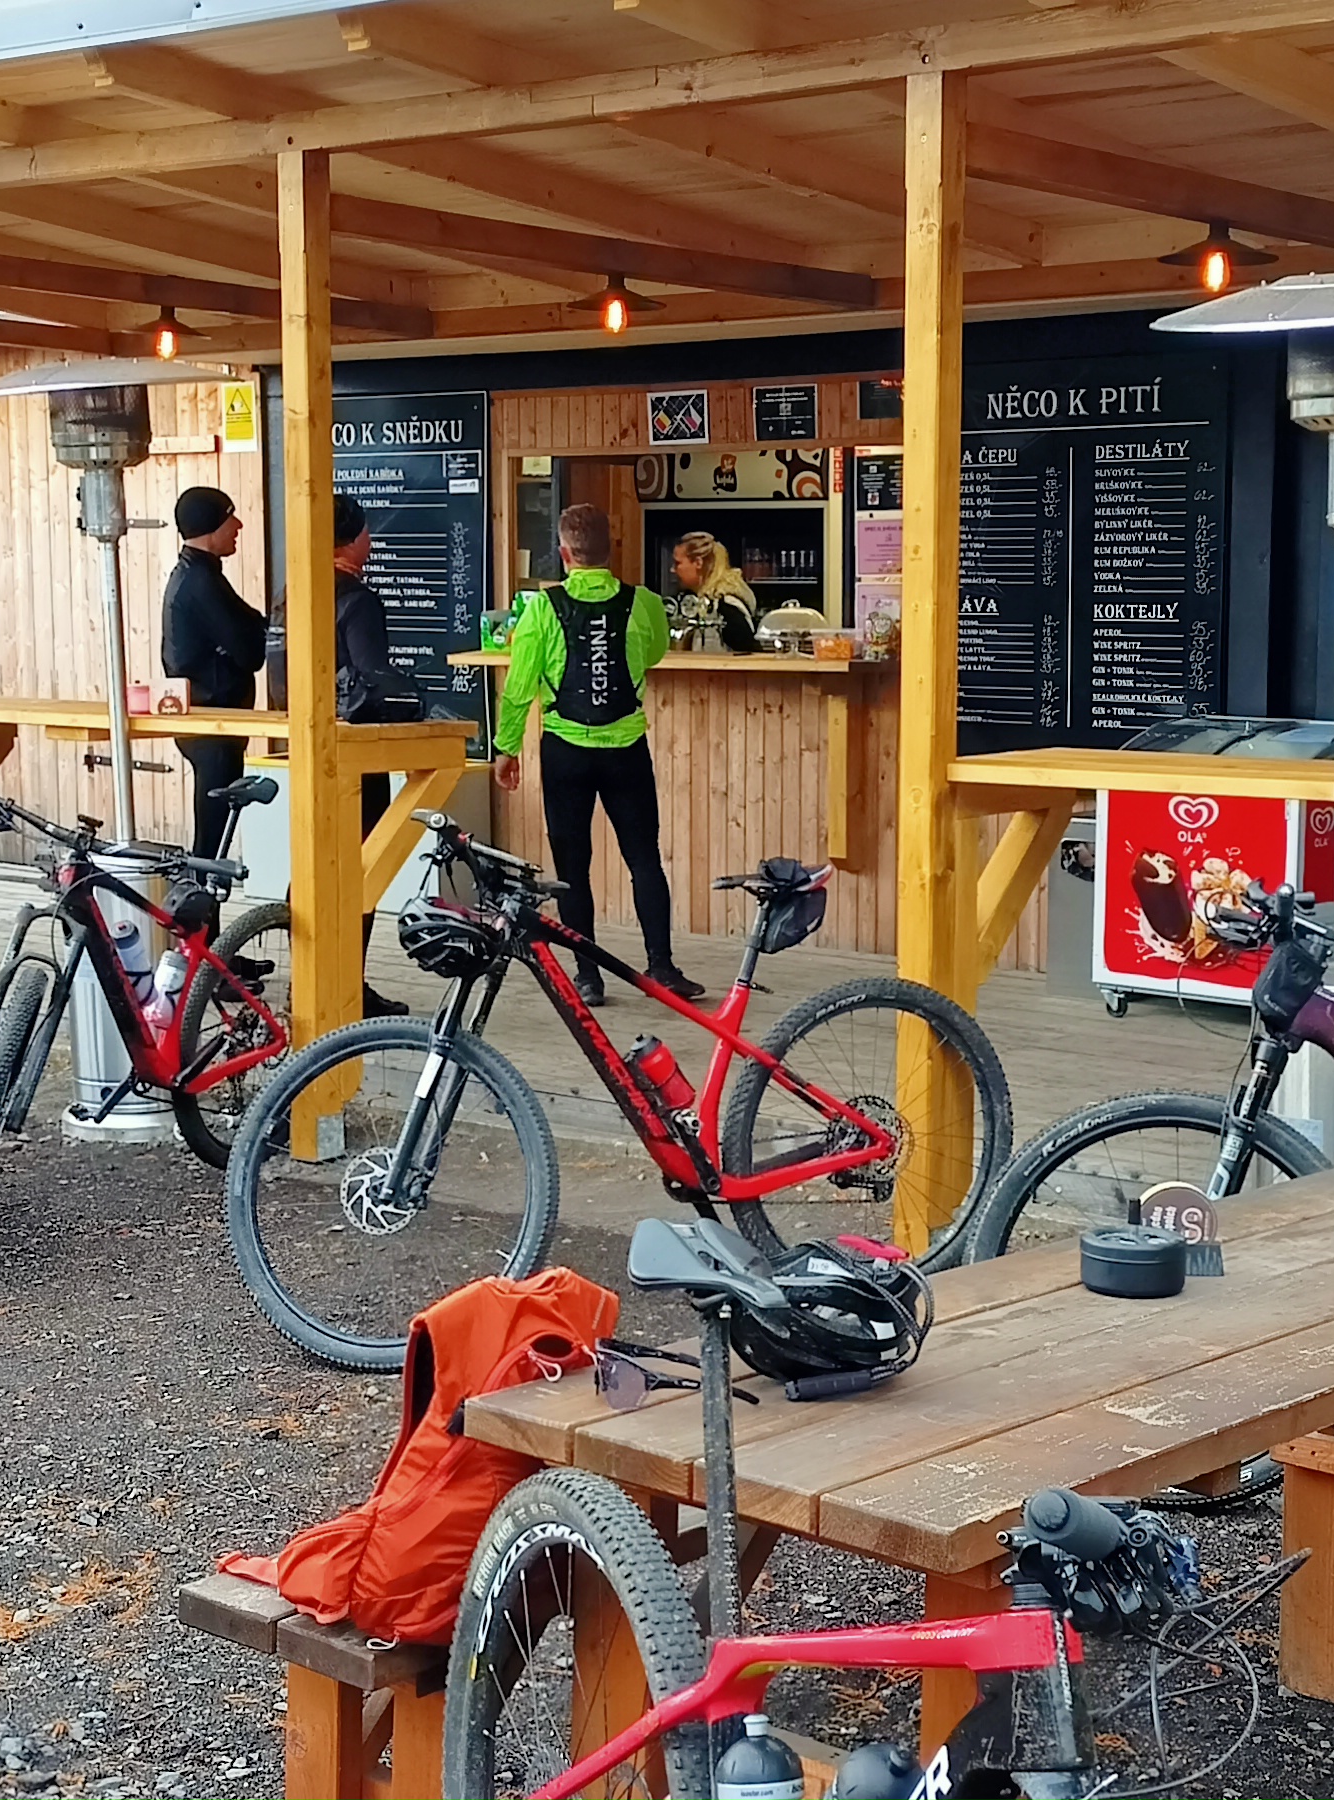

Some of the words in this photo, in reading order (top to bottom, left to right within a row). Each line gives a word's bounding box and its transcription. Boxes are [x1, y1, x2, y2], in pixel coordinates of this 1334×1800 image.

[986, 386, 1058, 420] NĚCO
[1068, 388, 1089, 416] K
[1099, 377, 1162, 415] PITÍ
[331, 421, 355, 447] CO
[362, 421, 376, 446] K
[383, 415, 464, 445] SNĚDKU
[978, 446, 1017, 464] ČEPU
[1095, 439, 1190, 459] DESTILÁTY
[961, 595, 998, 612] ÁVA
[1093, 602, 1179, 619] KOKTEJLY
[1177, 831, 1204, 844] OLA
[529, 937, 590, 1020] ROCK
[580, 1016, 669, 1143] MACHINE
